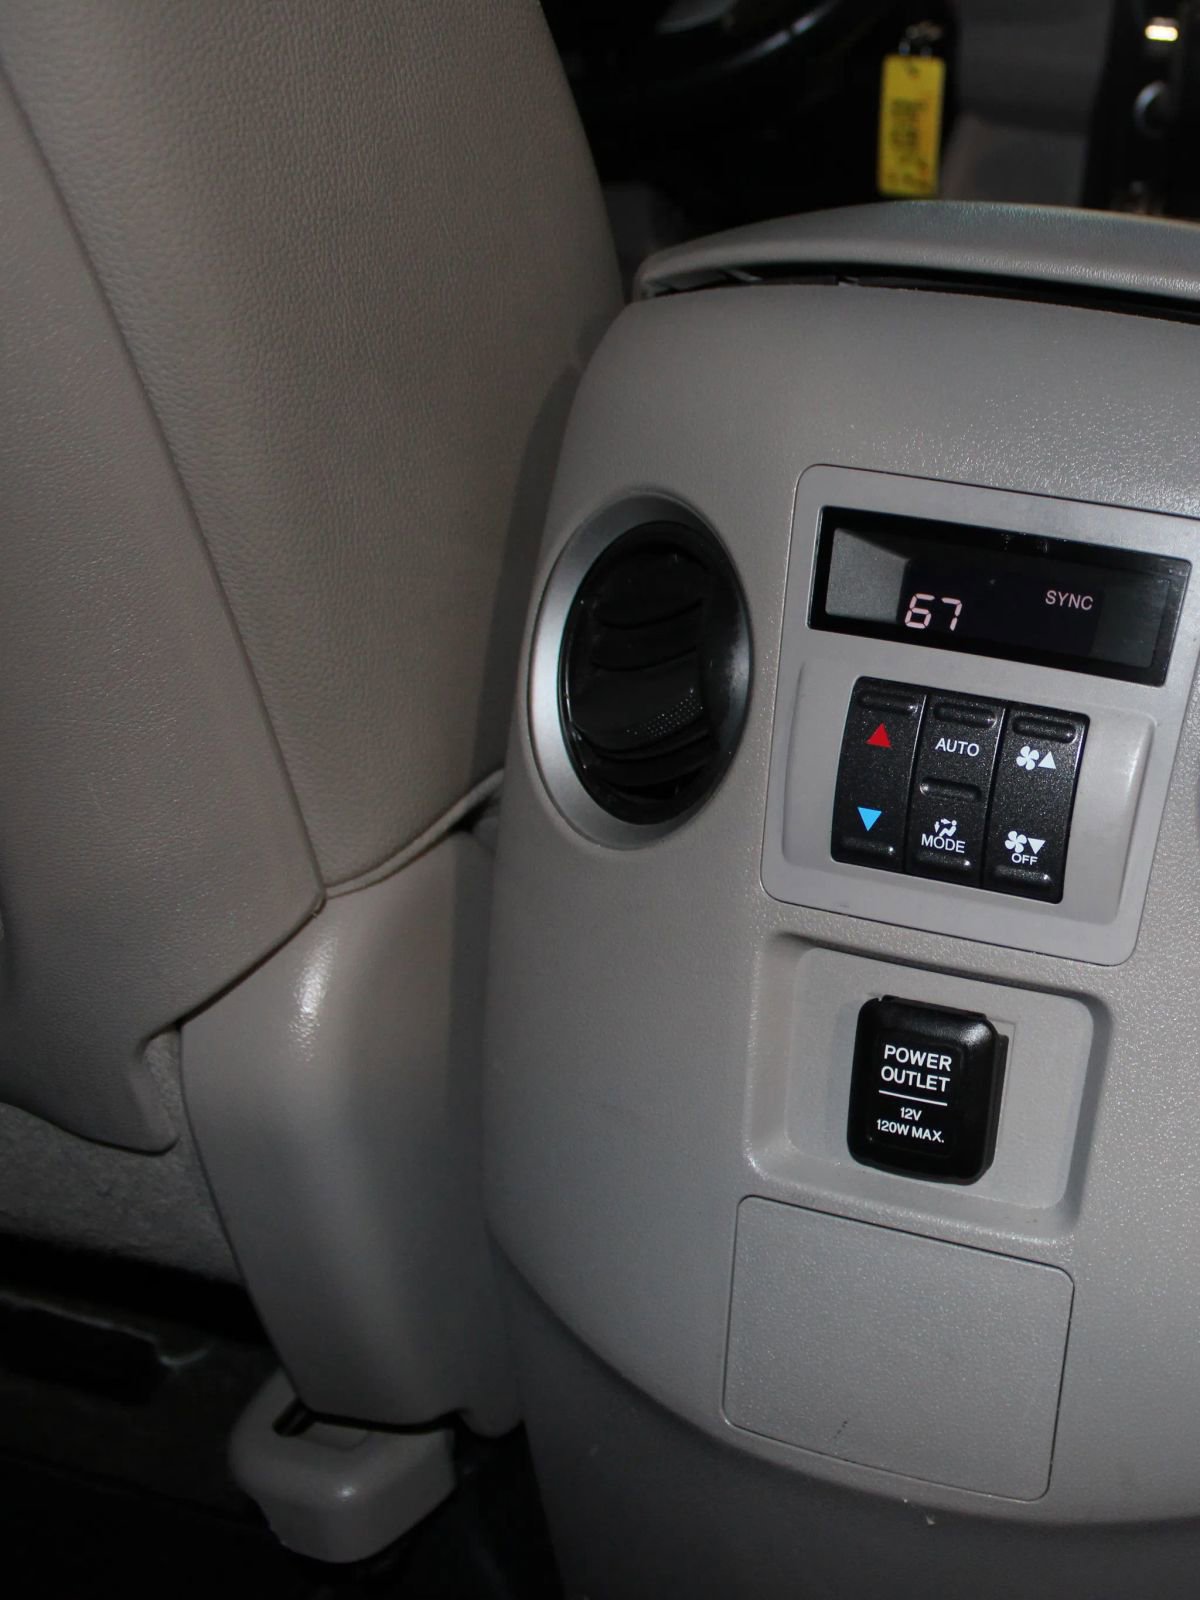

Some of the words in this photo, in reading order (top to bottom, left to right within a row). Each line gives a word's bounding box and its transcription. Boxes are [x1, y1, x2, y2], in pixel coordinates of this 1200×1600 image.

[1045, 589, 1094, 611] SYNC
[904, 593, 963, 632] 67
[935, 737, 980, 757] AUTO
[921, 833, 966, 854] MODE
[1011, 853, 1038, 866] OFF
[884, 1044, 952, 1072] POWER
[881, 1066, 950, 1092] OUTLET
[900, 1107, 922, 1121] 12V
[876, 1119, 910, 1136] 120W
[911, 1127, 945, 1143] MAX.
